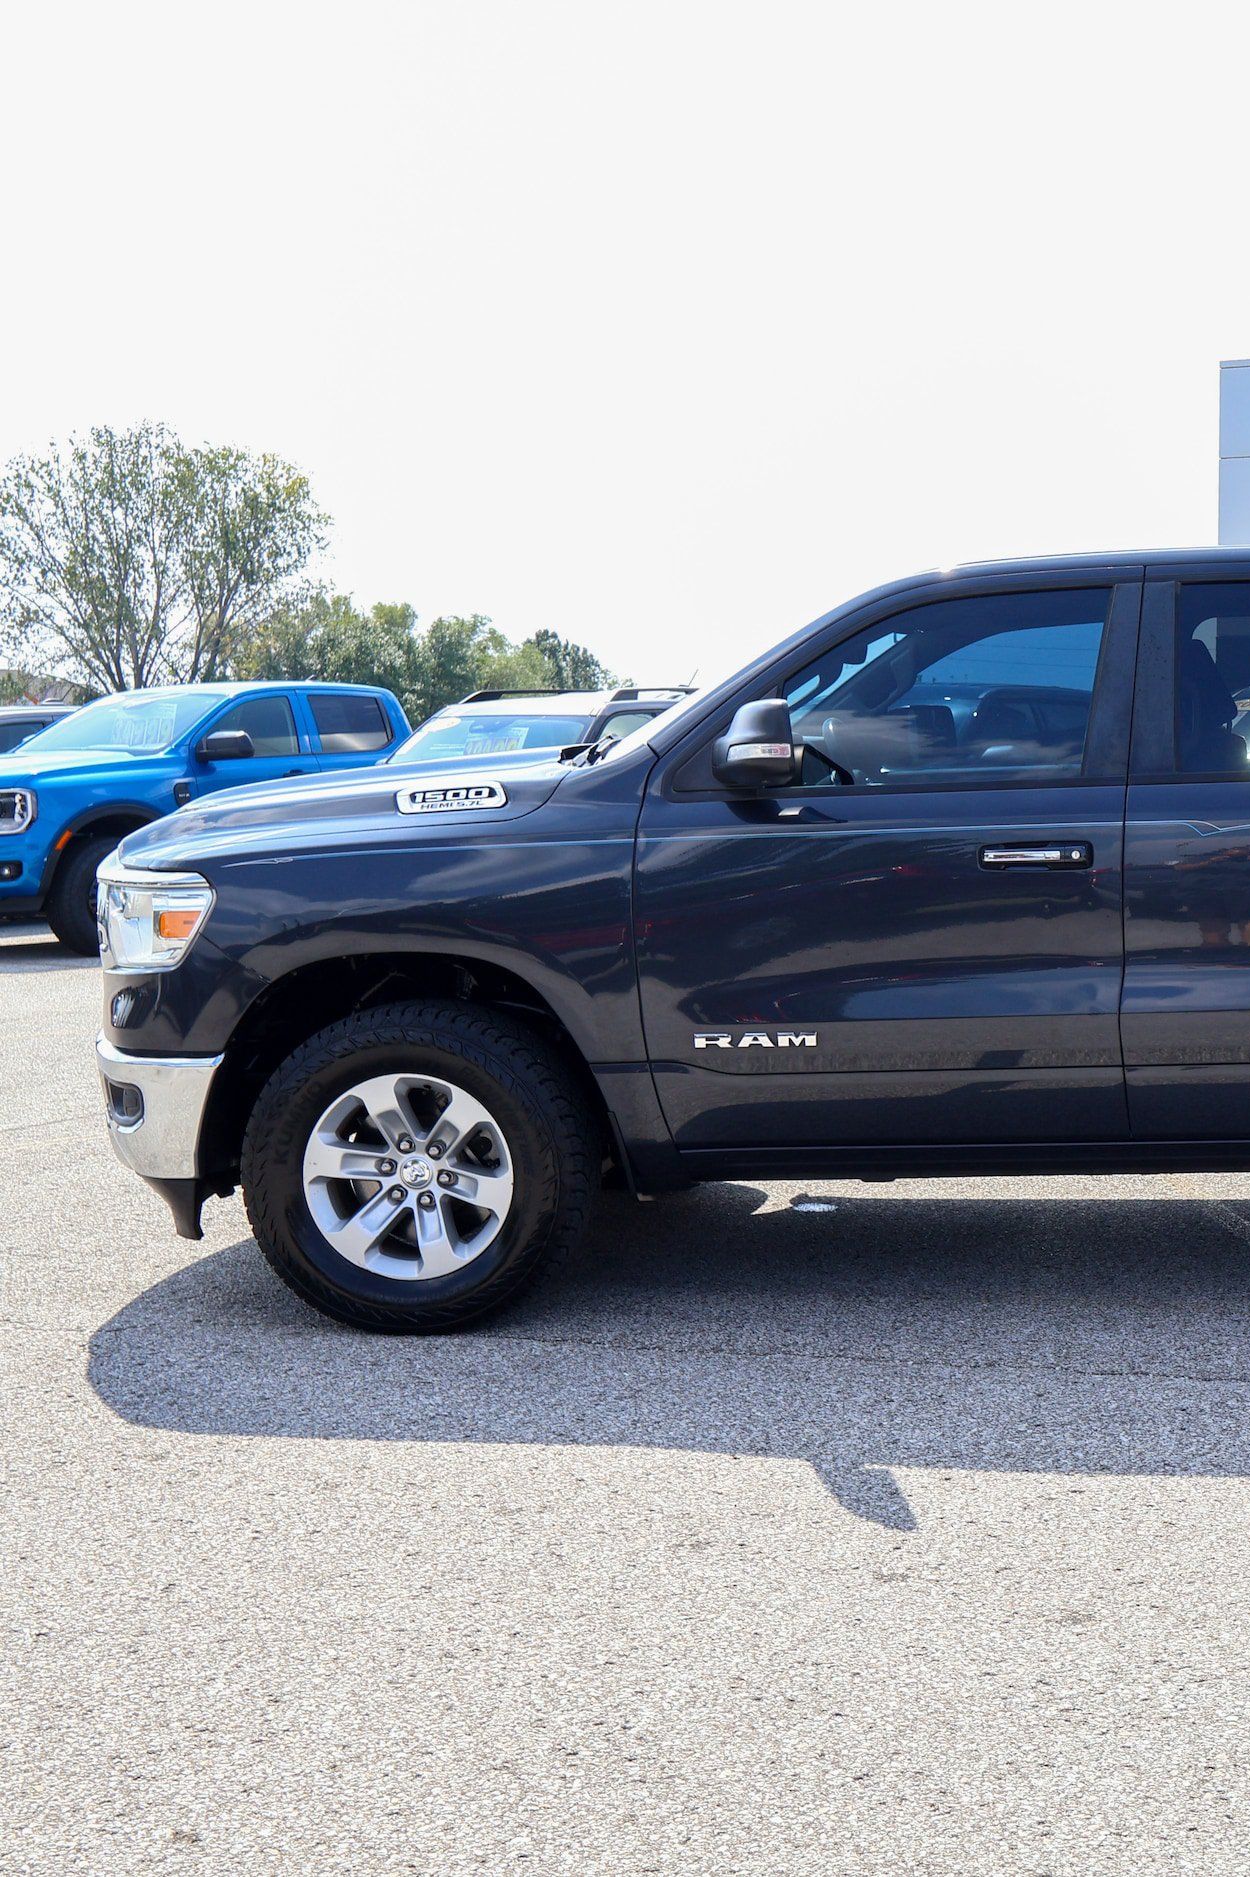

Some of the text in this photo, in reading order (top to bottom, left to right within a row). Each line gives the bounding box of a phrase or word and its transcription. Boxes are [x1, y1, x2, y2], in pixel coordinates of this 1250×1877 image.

[414, 788, 490, 803] 1500
[420, 800, 485, 810] HEMI 5.7L
[693, 1031, 818, 1049] RAM
